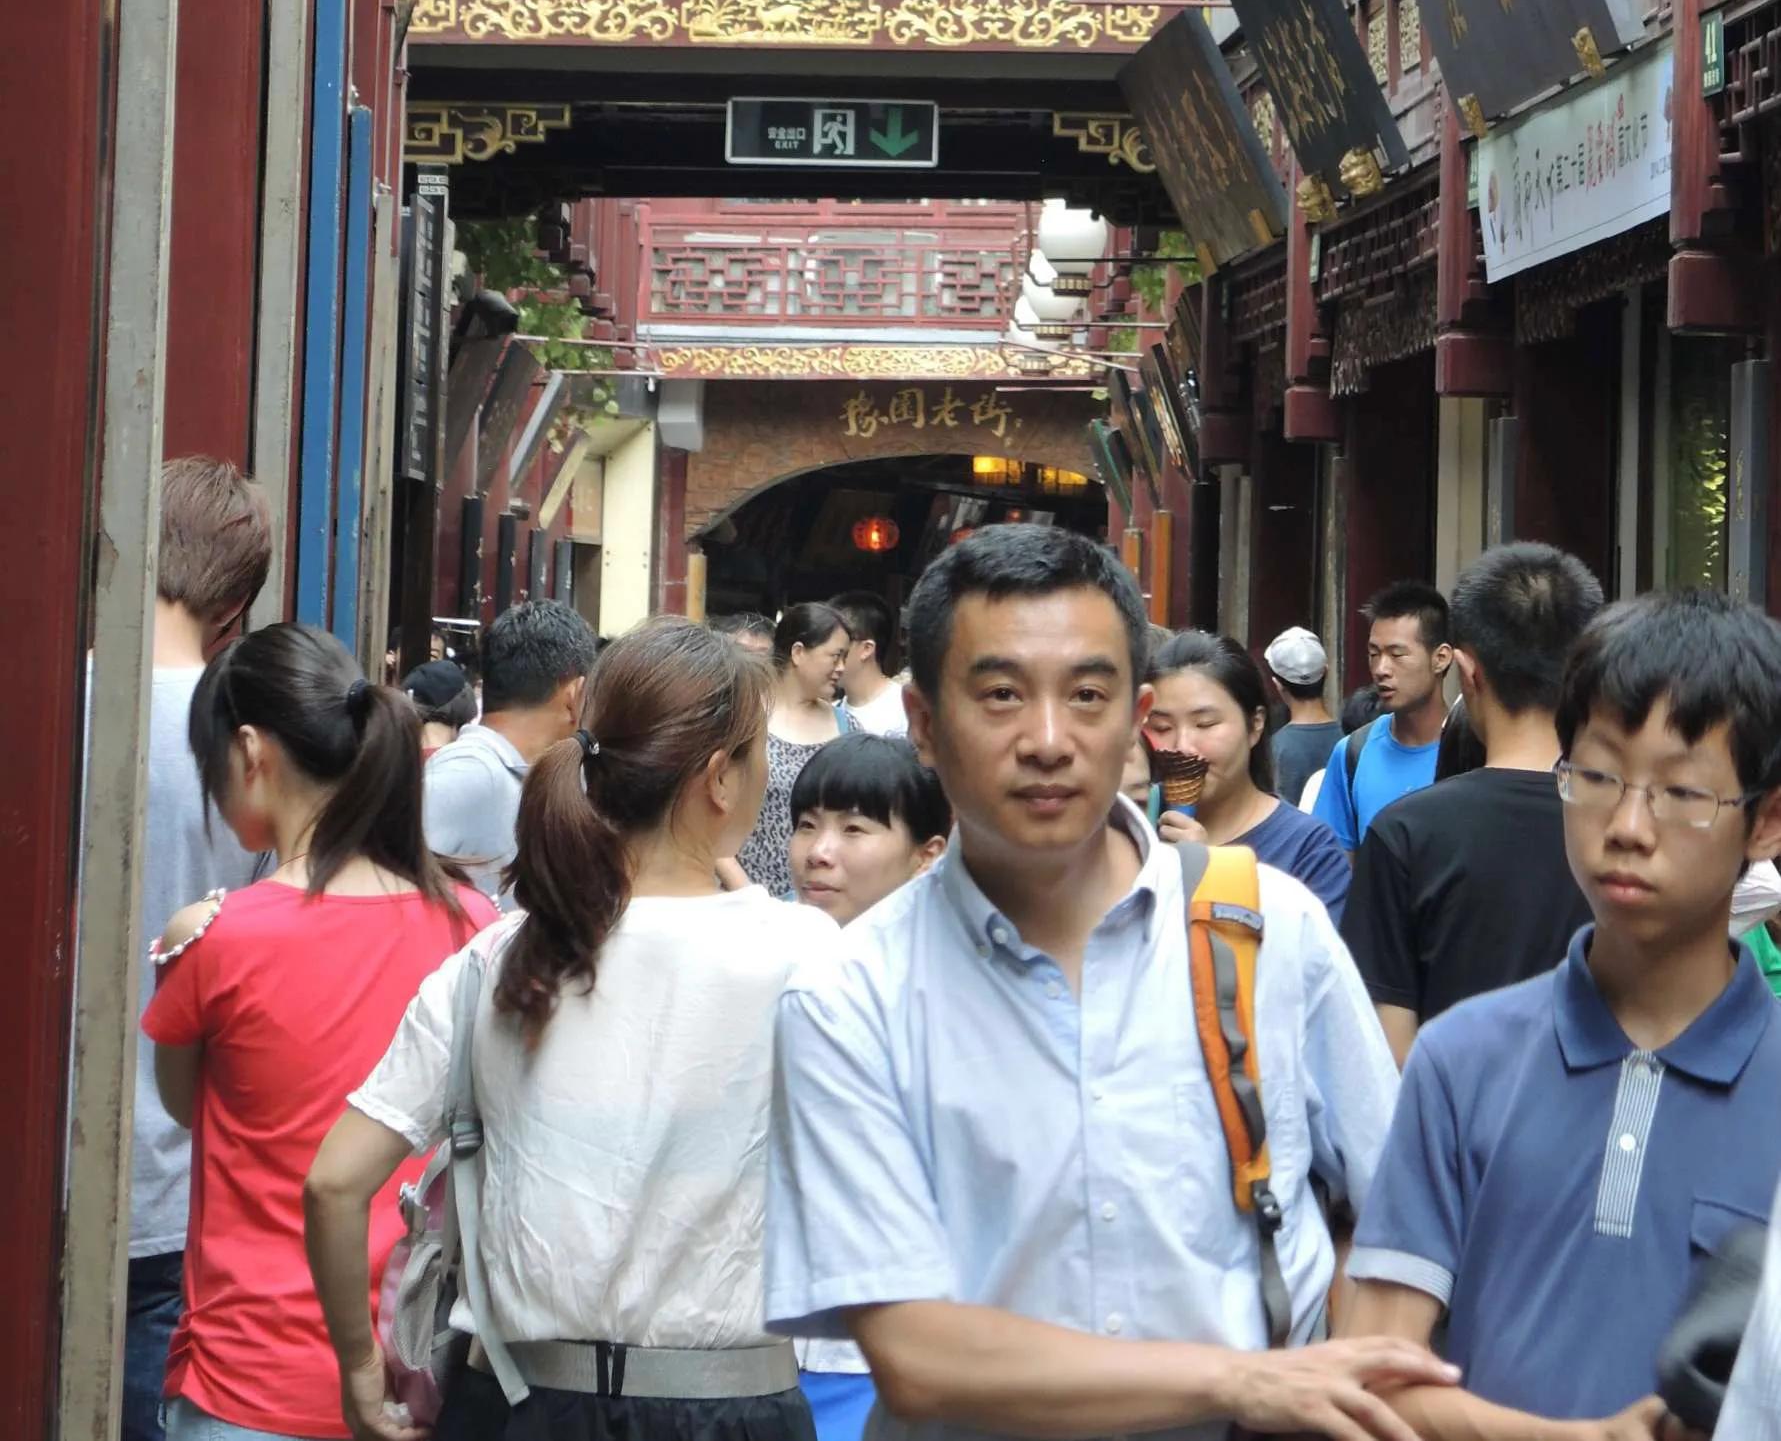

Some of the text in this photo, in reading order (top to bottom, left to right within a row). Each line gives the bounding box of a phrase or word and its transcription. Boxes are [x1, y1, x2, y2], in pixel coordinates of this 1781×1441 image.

[767, 126, 806, 140] 安全出口
[774, 140, 800, 150] EXIT
